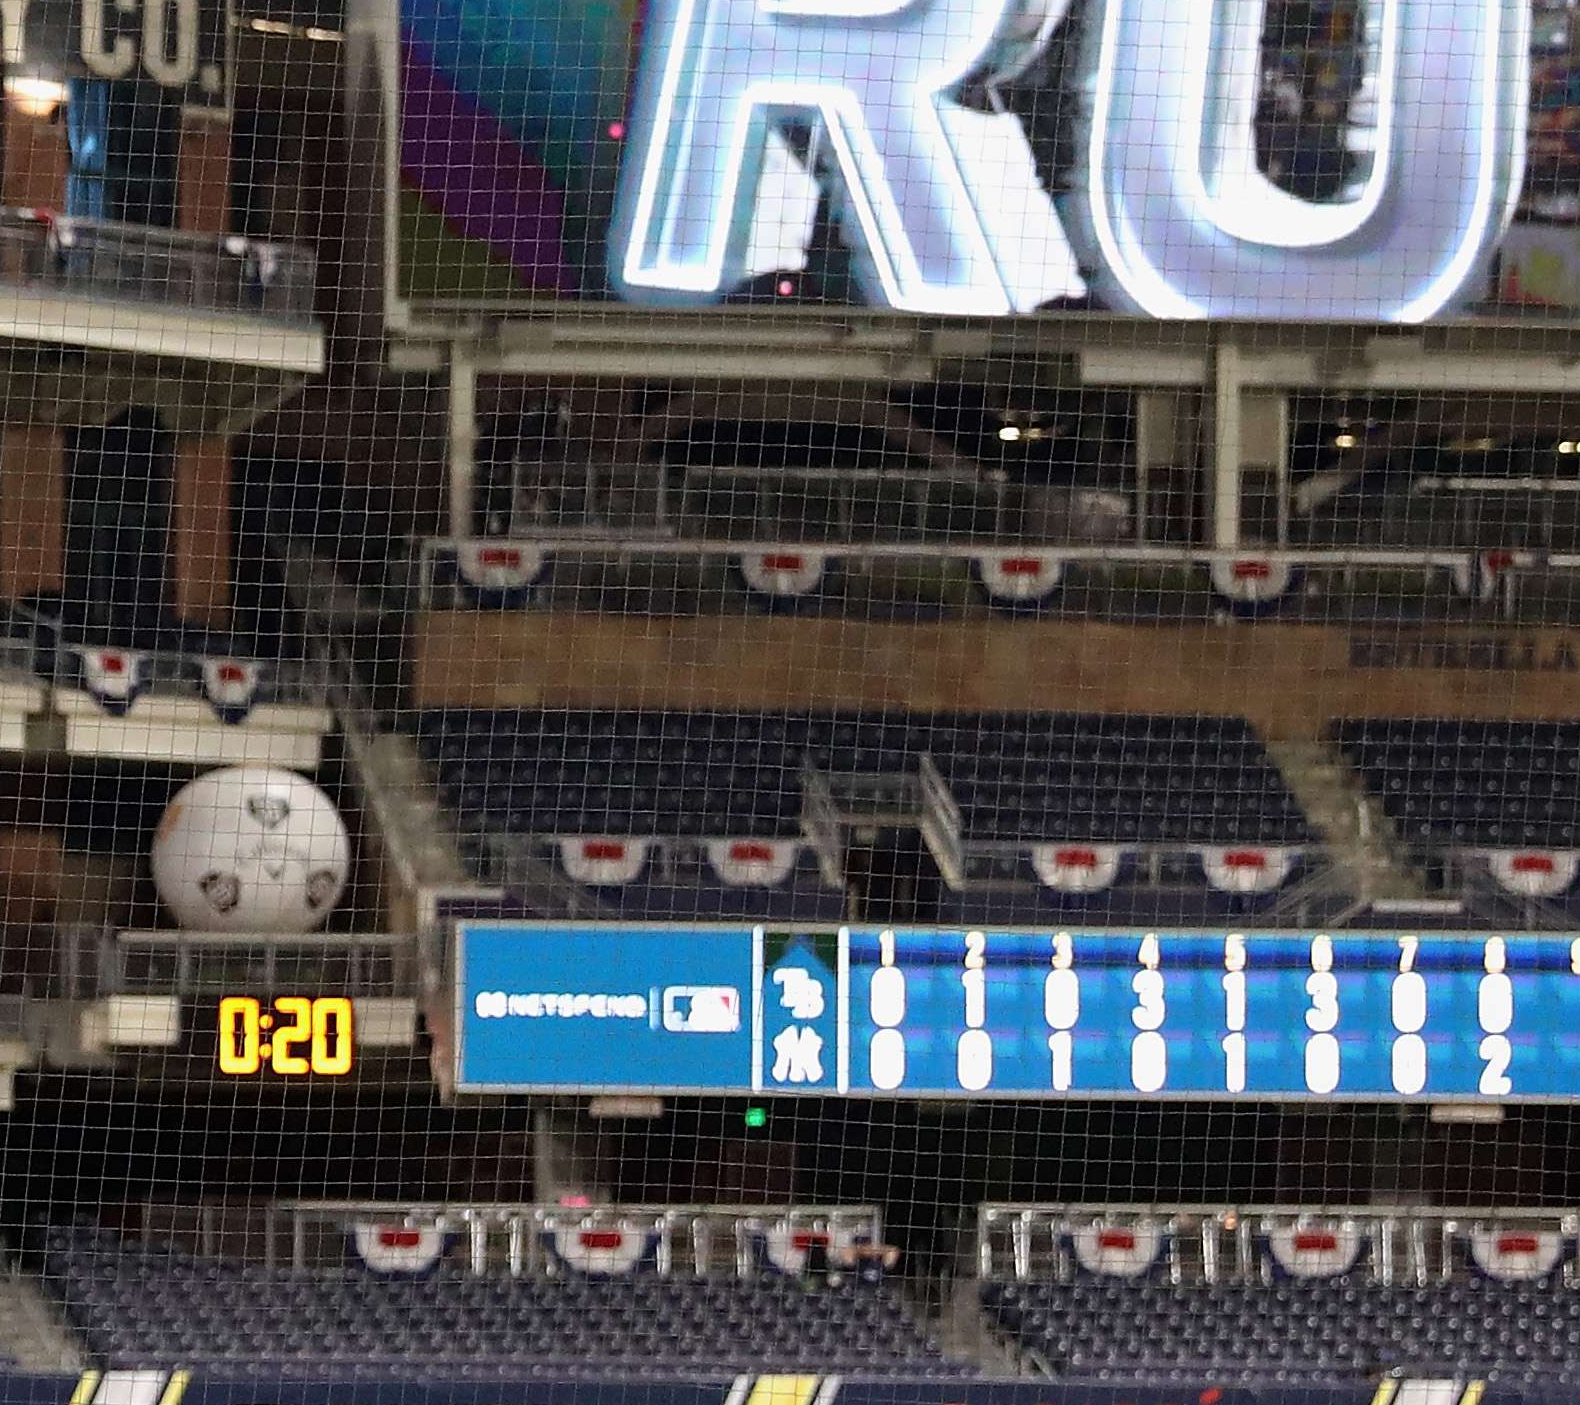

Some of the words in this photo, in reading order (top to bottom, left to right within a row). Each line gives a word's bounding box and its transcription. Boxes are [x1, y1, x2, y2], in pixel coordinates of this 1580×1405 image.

[879, 929, 894, 966] 1
[965, 931, 985, 966] 2
[1052, 931, 1073, 967] 3
[1138, 933, 1159, 968] 4
[1225, 934, 1246, 969] 5
[1399, 935, 1418, 971] 7
[870, 967, 905, 1027] 0
[962, 967, 985, 1028] 1
[1045, 968, 1079, 1029] 0
[1132, 969, 1165, 1030] 3
[1222, 970, 1246, 1031] 1
[1305, 970, 1339, 1031] 3
[1392, 971, 1426, 1032] 0
[1479, 972, 1513, 1033] 0
[219, 997, 353, 1076] 0:20
[870, 1028, 905, 1090] 0
[958, 1029, 992, 1091] 0
[1048, 1030, 1072, 1091] 1
[1132, 1031, 1166, 1093] 0
[1222, 1032, 1246, 1093] 1
[1305, 1033, 1339, 1094] 0
[1392, 1033, 1426, 1095] 0
[1479, 1034, 1512, 1095] 2
